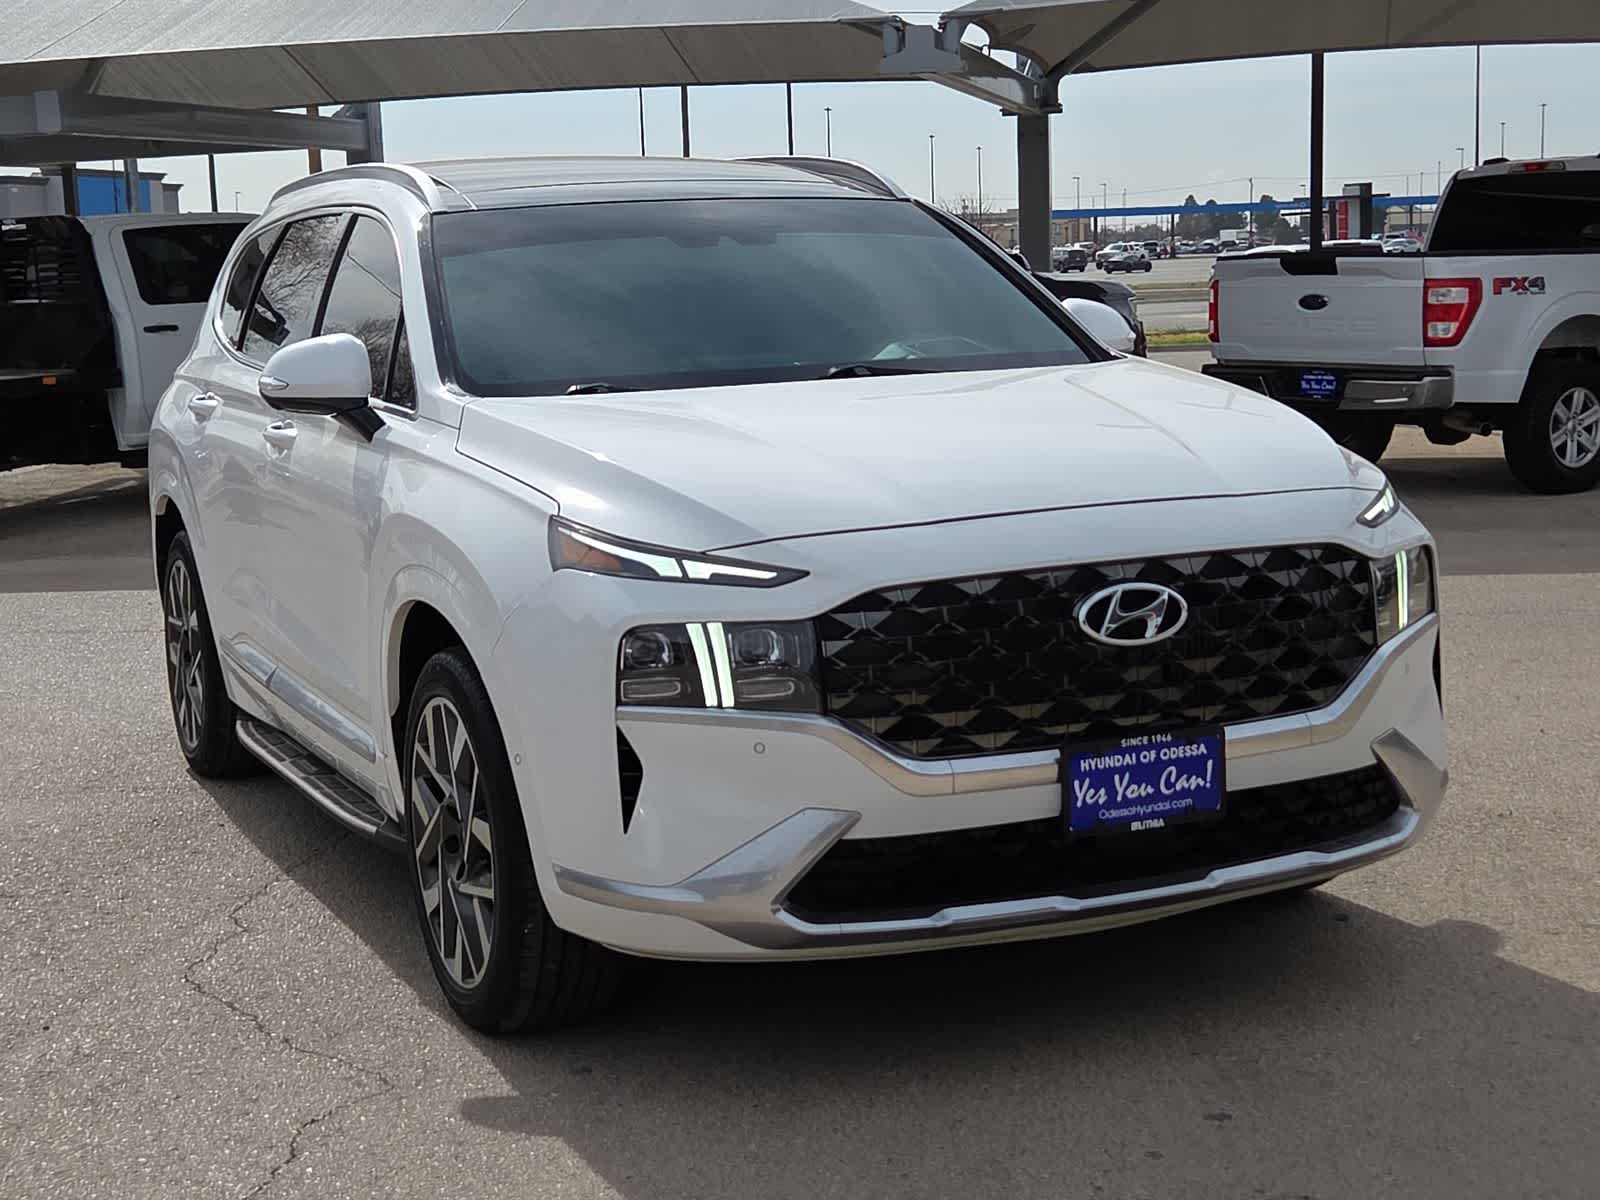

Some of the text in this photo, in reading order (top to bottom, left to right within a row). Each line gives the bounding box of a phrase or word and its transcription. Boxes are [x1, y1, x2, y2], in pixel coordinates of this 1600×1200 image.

[1493, 276, 1546, 295] FX4
[1120, 732, 1173, 748] SINCE 1946
[1080, 743, 1208, 773] HYUNDAI OF ODESSA
[1073, 758, 1214, 808] Yes You Can!
[1098, 797, 1193, 819] OdessaHyundai.com
